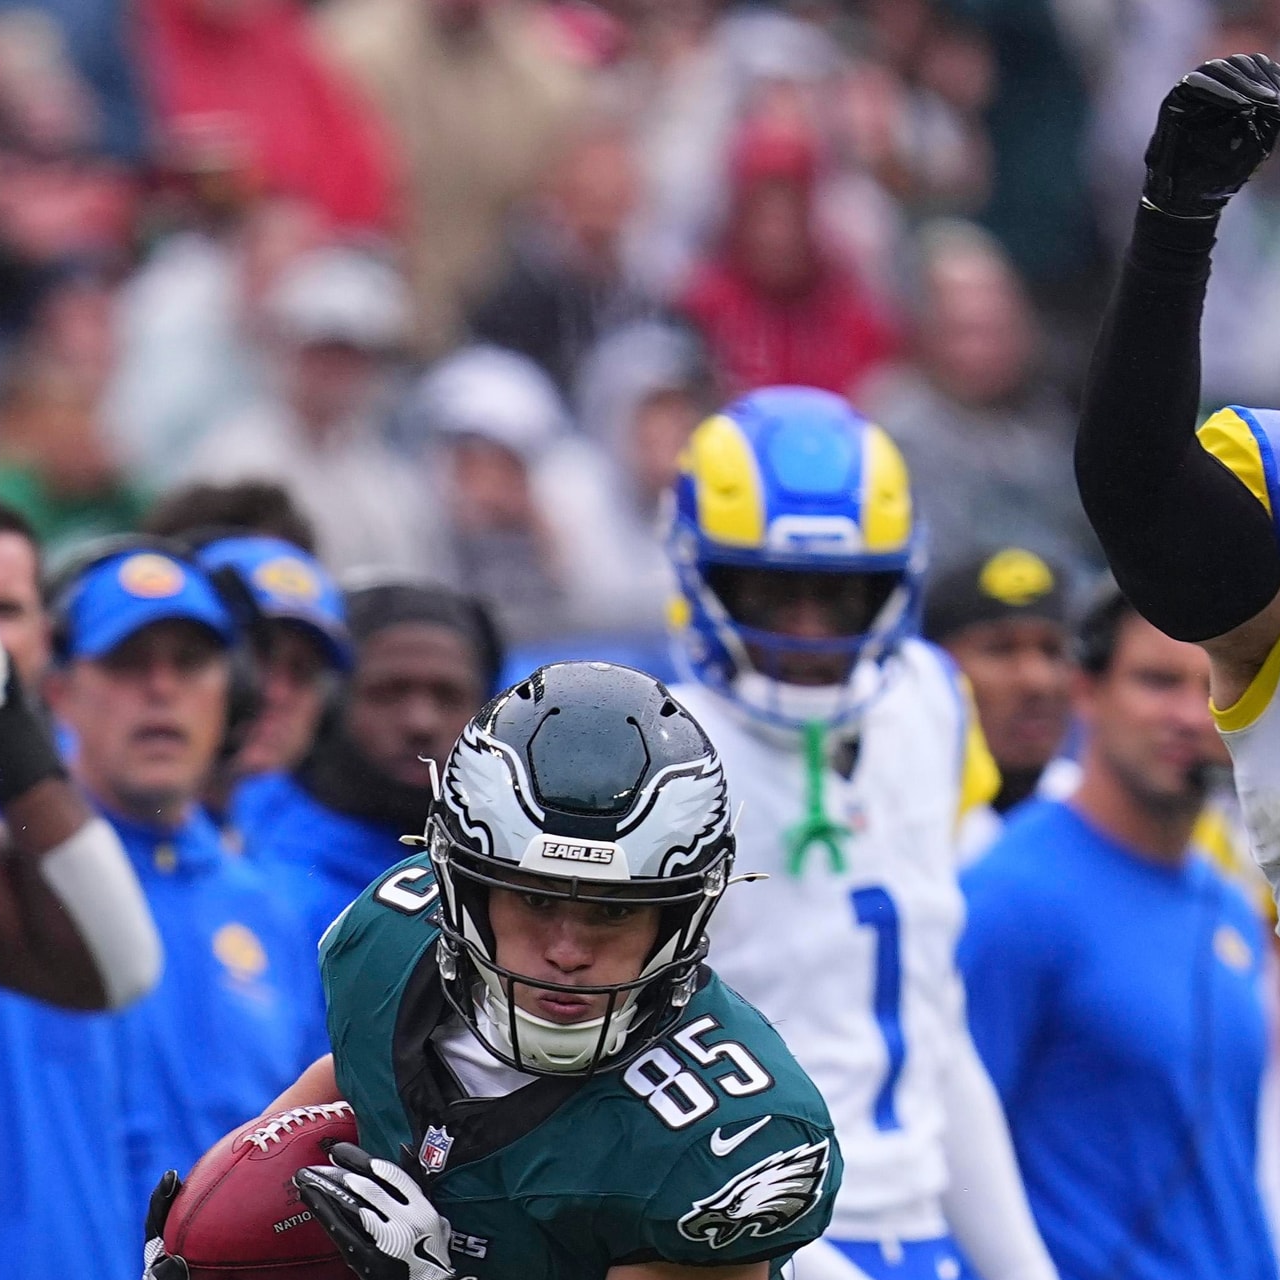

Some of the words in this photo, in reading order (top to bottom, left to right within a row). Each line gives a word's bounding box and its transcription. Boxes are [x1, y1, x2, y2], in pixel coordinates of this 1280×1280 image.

[542, 842, 615, 864] EAGLES
[850, 886, 906, 1131] 1
[622, 1015, 773, 1129] 85
[273, 1210, 316, 1234] NATIO
